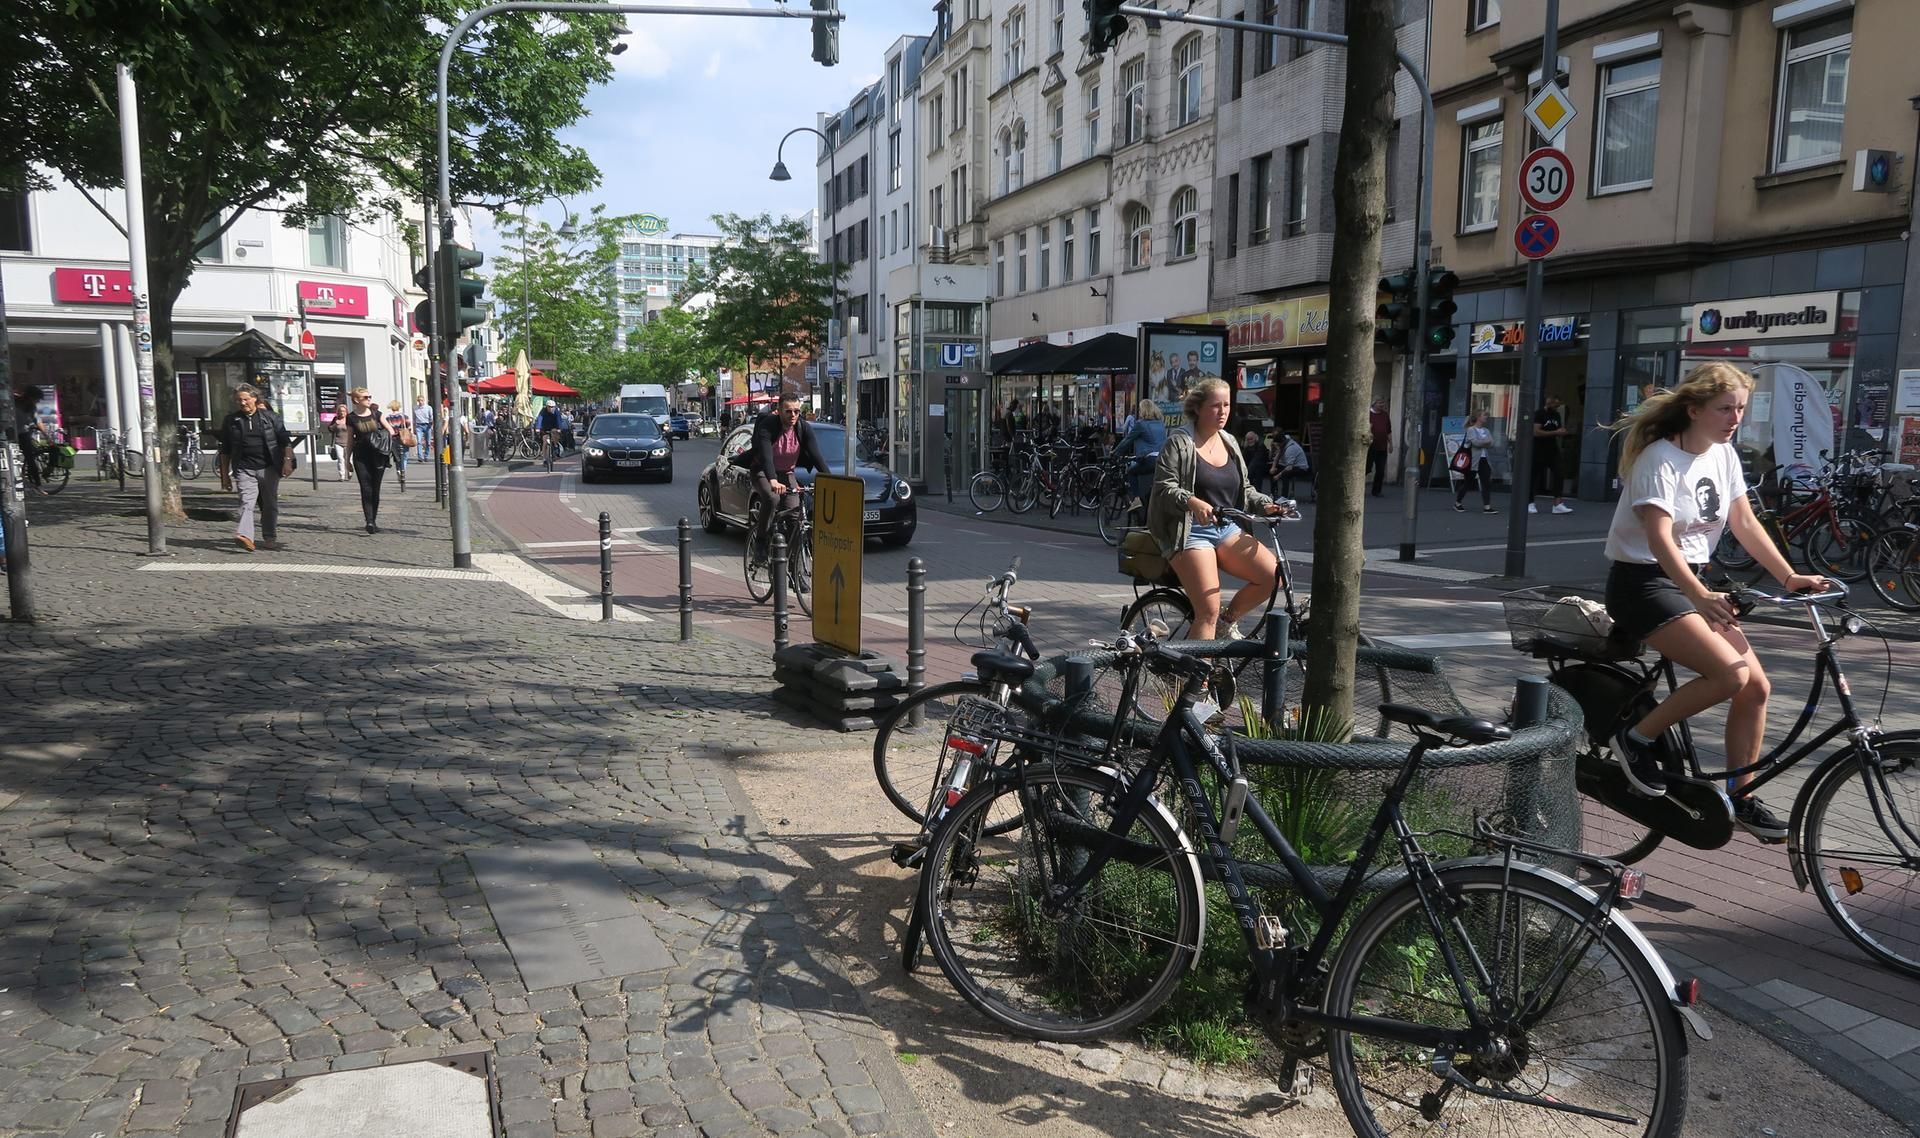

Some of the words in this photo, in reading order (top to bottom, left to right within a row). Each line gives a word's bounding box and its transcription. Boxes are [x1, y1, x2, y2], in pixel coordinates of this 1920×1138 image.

[1531, 165, 1563, 195] 30
[639, 219, 658, 229] 4711
[83, 273, 106, 297] T
[1211, 311, 1286, 346] amla
[1539, 316, 1575, 342] travel
[1724, 305, 1828, 334] unitymedia
[943, 345, 962, 364] U
[1162, 413, 1187, 427] REIS
[823, 487, 836, 525] U
[818, 530, 855, 552] Philippstr.
[1183, 778, 1255, 929] Gudereit
